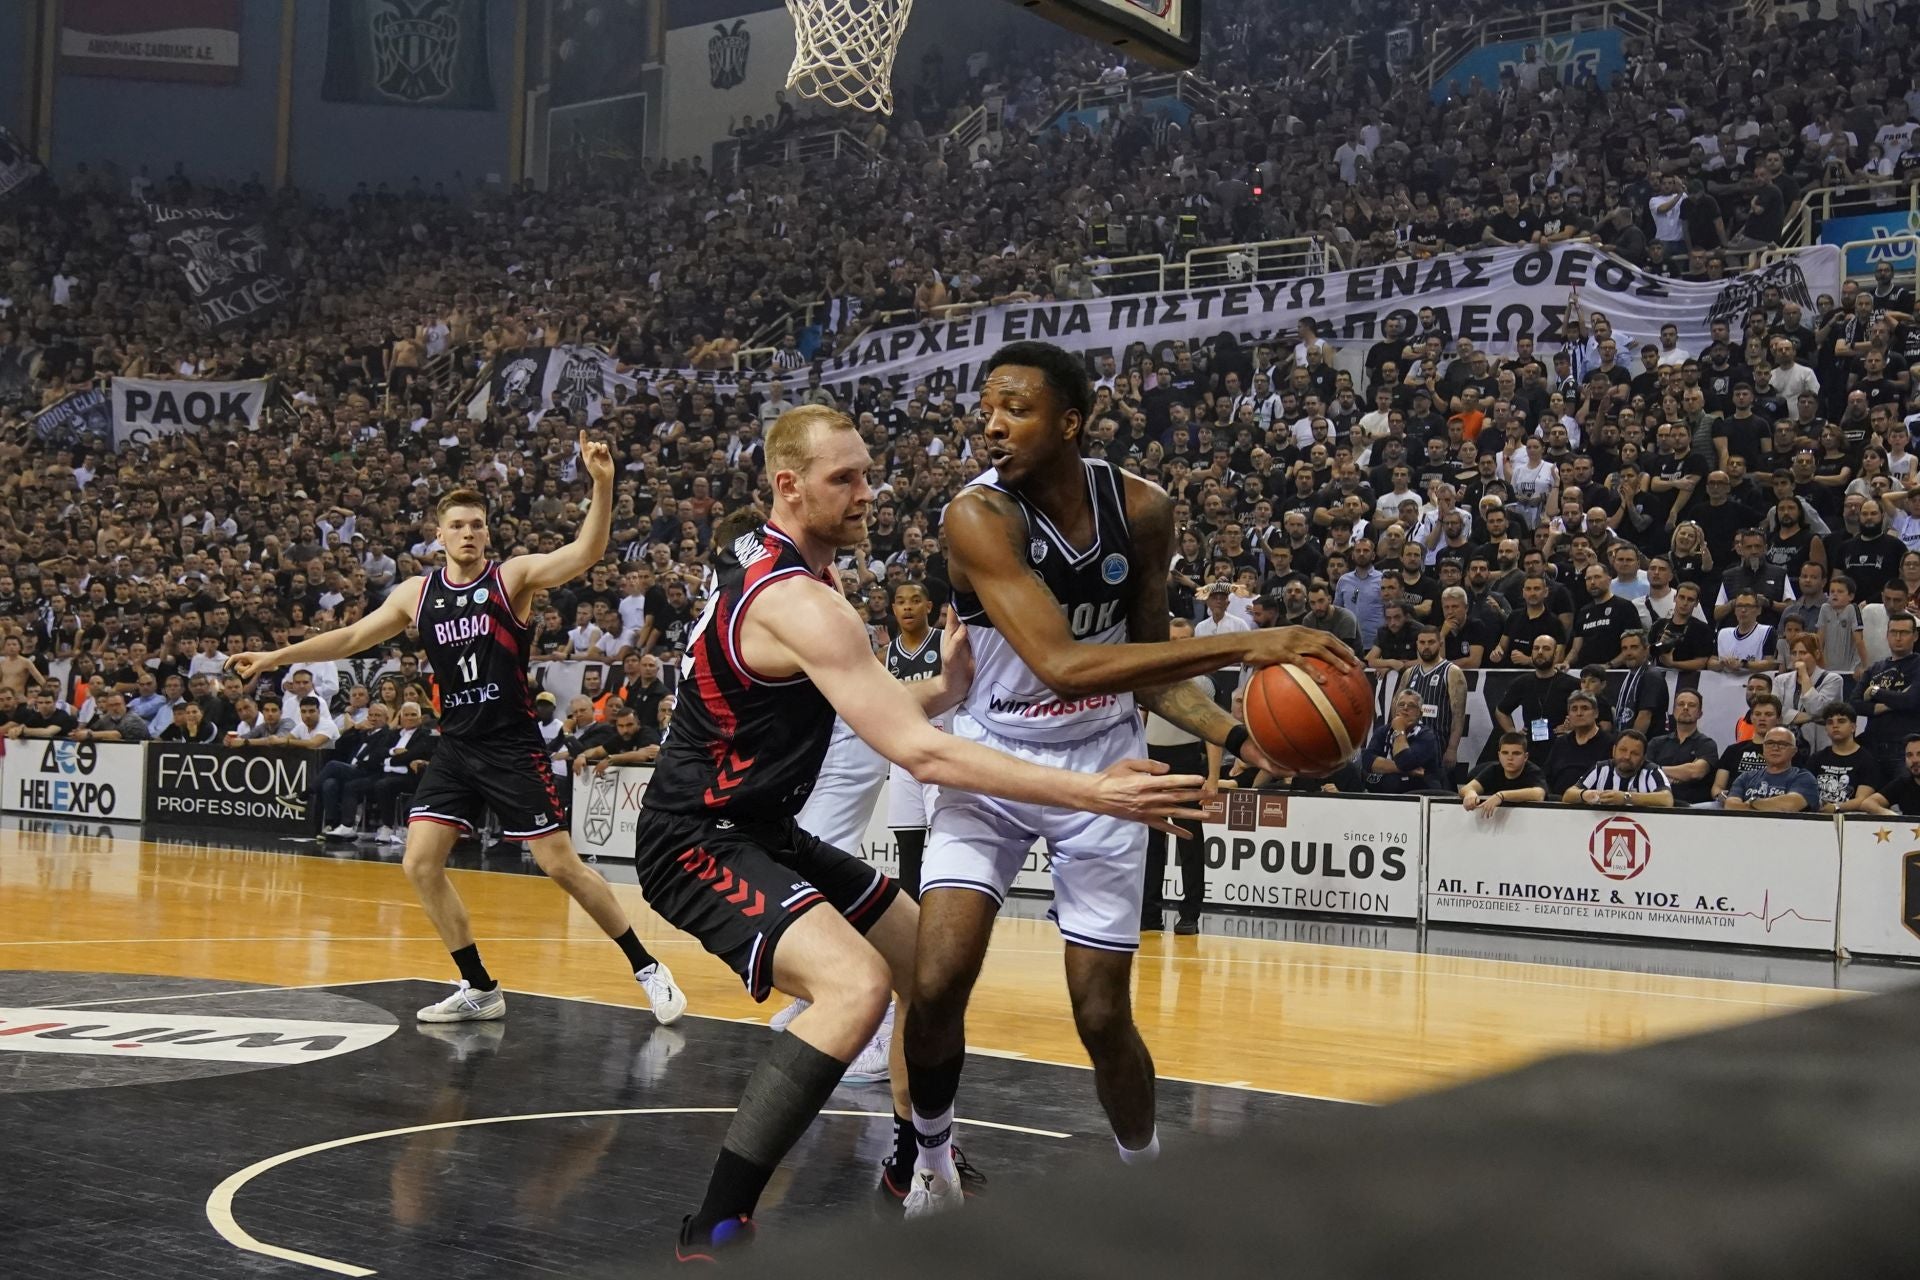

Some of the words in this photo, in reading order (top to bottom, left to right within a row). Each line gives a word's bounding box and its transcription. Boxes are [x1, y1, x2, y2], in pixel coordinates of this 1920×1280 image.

[1002, 304, 1091, 343] ΕΝΑ
[1108, 276, 1325, 331] ΠΙΣΤΕΥΩ
[1346, 255, 1494, 303] ΕΝΑΣ
[1512, 250, 1669, 298] ΘΕΟΣ
[125, 389, 253, 426] PAOK
[434, 613, 490, 645] BILBAO
[1060, 599, 1119, 636] OK
[457, 652, 479, 683] 11
[158, 753, 307, 796] FARCOM
[20, 778, 116, 815] HELEXPO
[157, 796, 306, 821] PROFESSIONAL
[1343, 831, 1375, 842] since
[1379, 832, 1408, 844] 1960
[1224, 883, 1390, 913] CONSTRUCTION
[1437, 878, 1467, 893] ΑΠ.
[1476, 881, 1490, 895] Γ.
[1499, 882, 1600, 903] ΠΑΠΟΥΔΗΣ
[1609, 889, 1625, 904] &
[1635, 891, 1680, 908] ΥΙΟΣ
[1436, 897, 1521, 912] ΑΝΤΙΠΡΟΣΩΠΕΙΕΣ
[1534, 904, 1590, 917] ΕΙΣΑΓΩΓΕΣ
[1594, 908, 1643, 921] ΙΑΤΡΙΚΩΝ
[1648, 912, 1735, 928] ΜΗΧΑΝΗΜΑΤΩΝ
